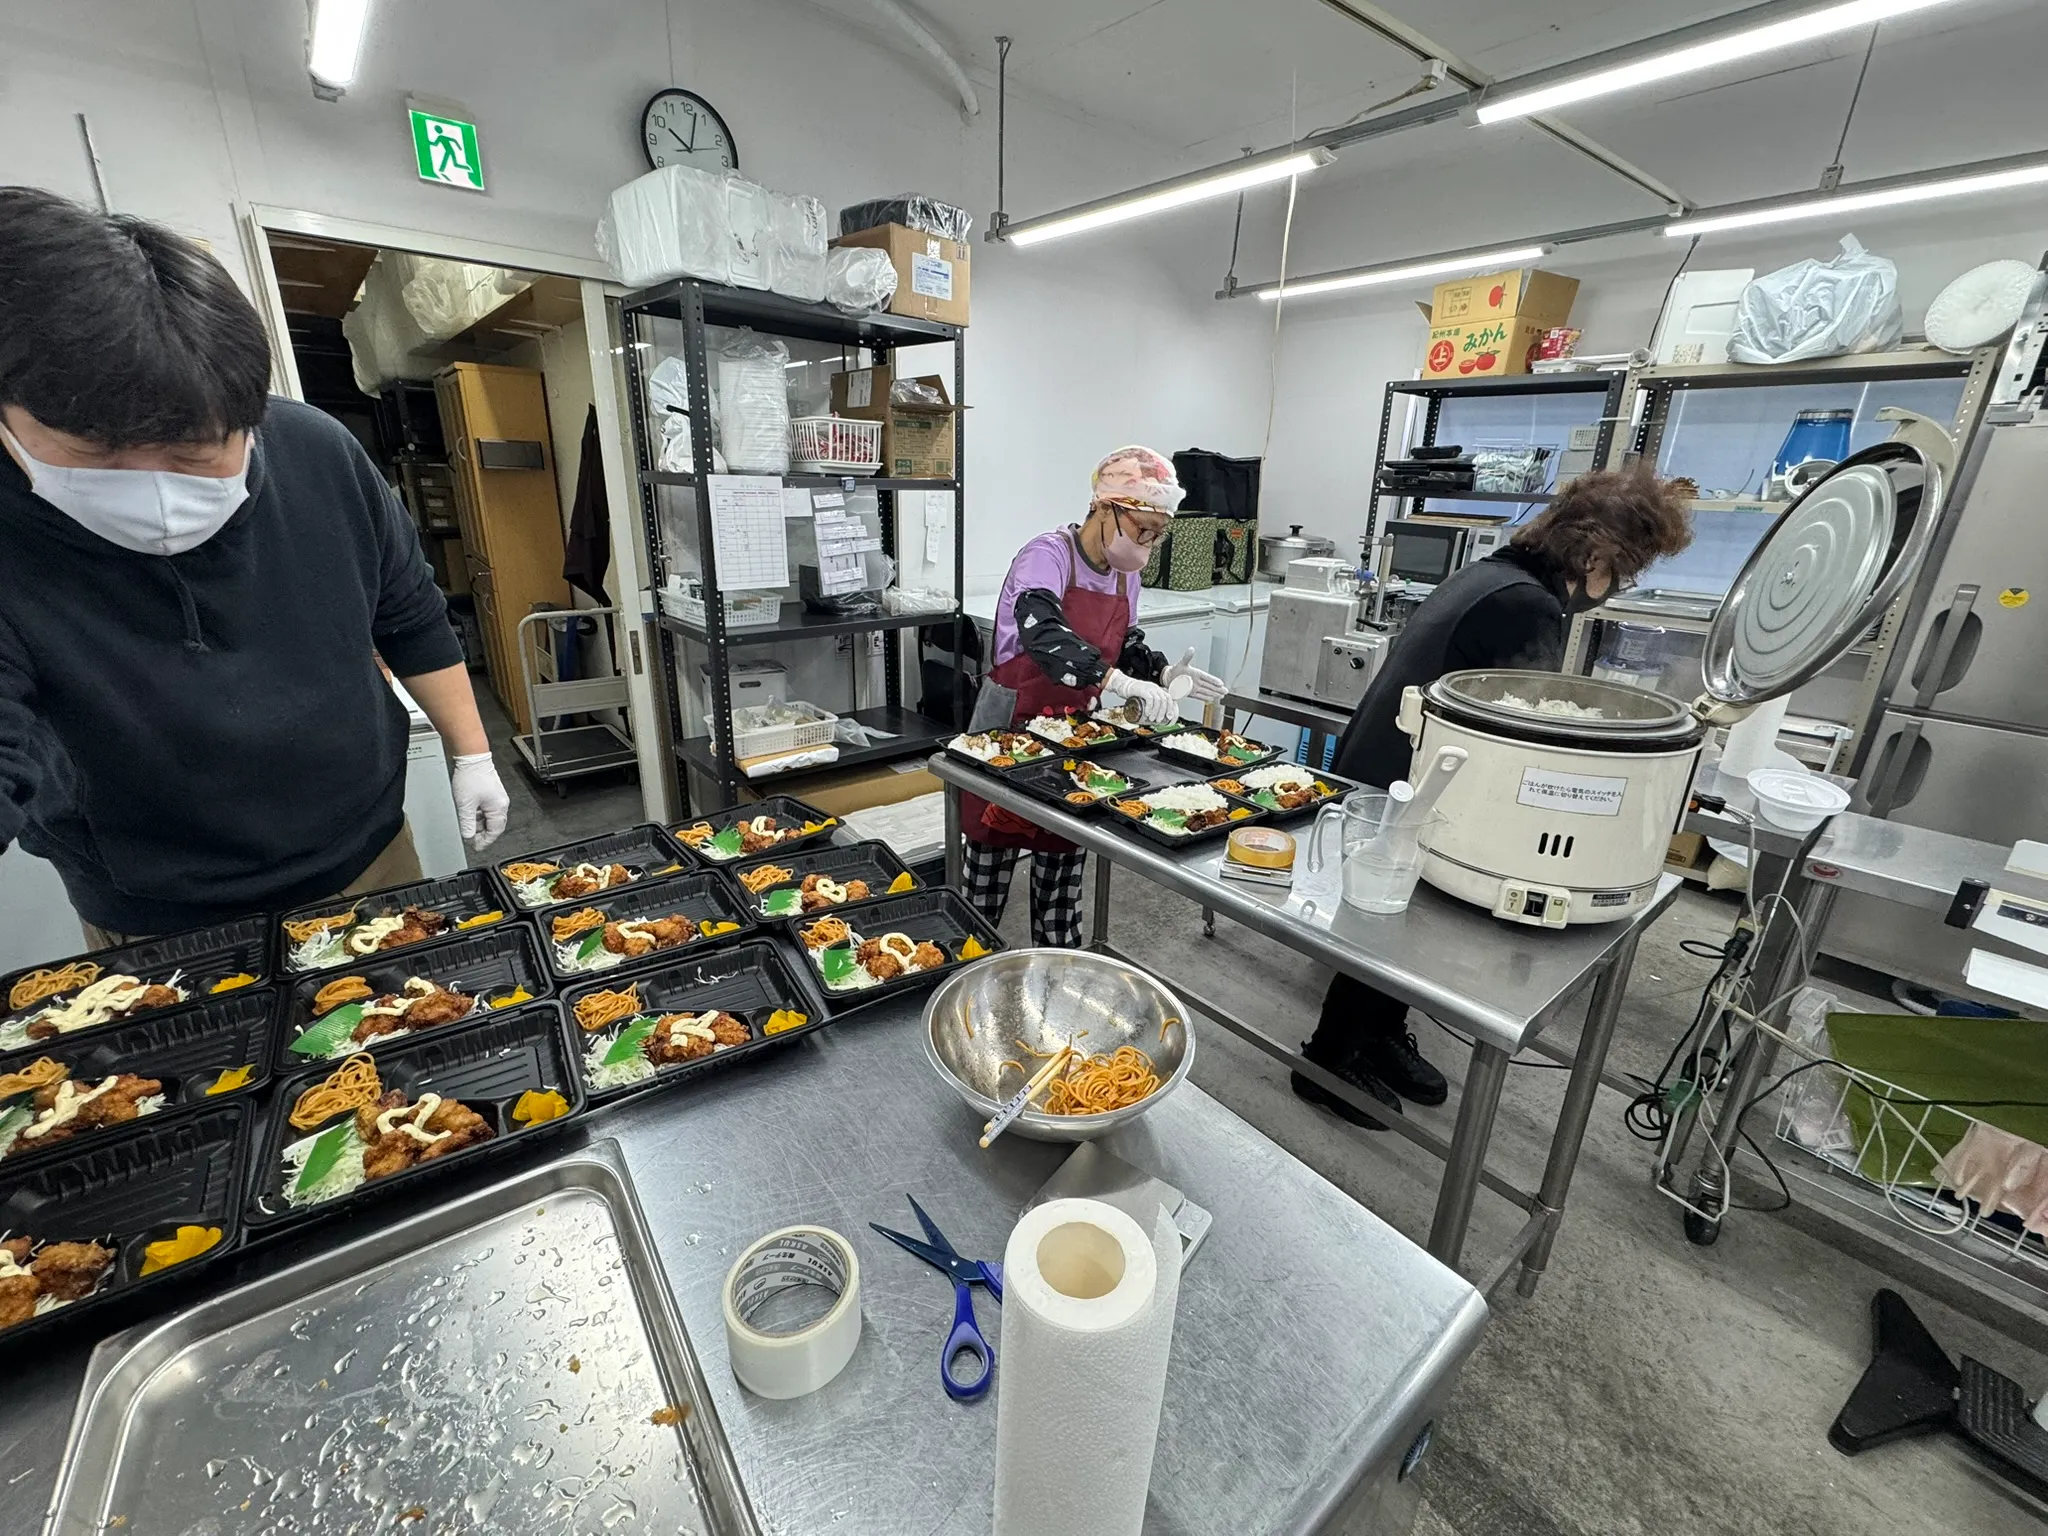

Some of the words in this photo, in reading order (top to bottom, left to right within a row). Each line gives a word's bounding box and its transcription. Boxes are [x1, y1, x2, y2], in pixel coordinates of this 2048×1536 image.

[663, 100, 675, 116] 11
[680, 101, 694, 116] 12
[651, 113, 666, 129] 10
[700, 114, 707, 127] 1
[648, 132, 658, 146] 9
[714, 134, 723, 147] 2
[656, 156, 665, 168] 8
[721, 155, 729, 168] 3
[1463, 322, 1508, 353] みかん
[779, 1239, 809, 1250] ASKUL
[807, 1257, 833, 1277] ASKUL
